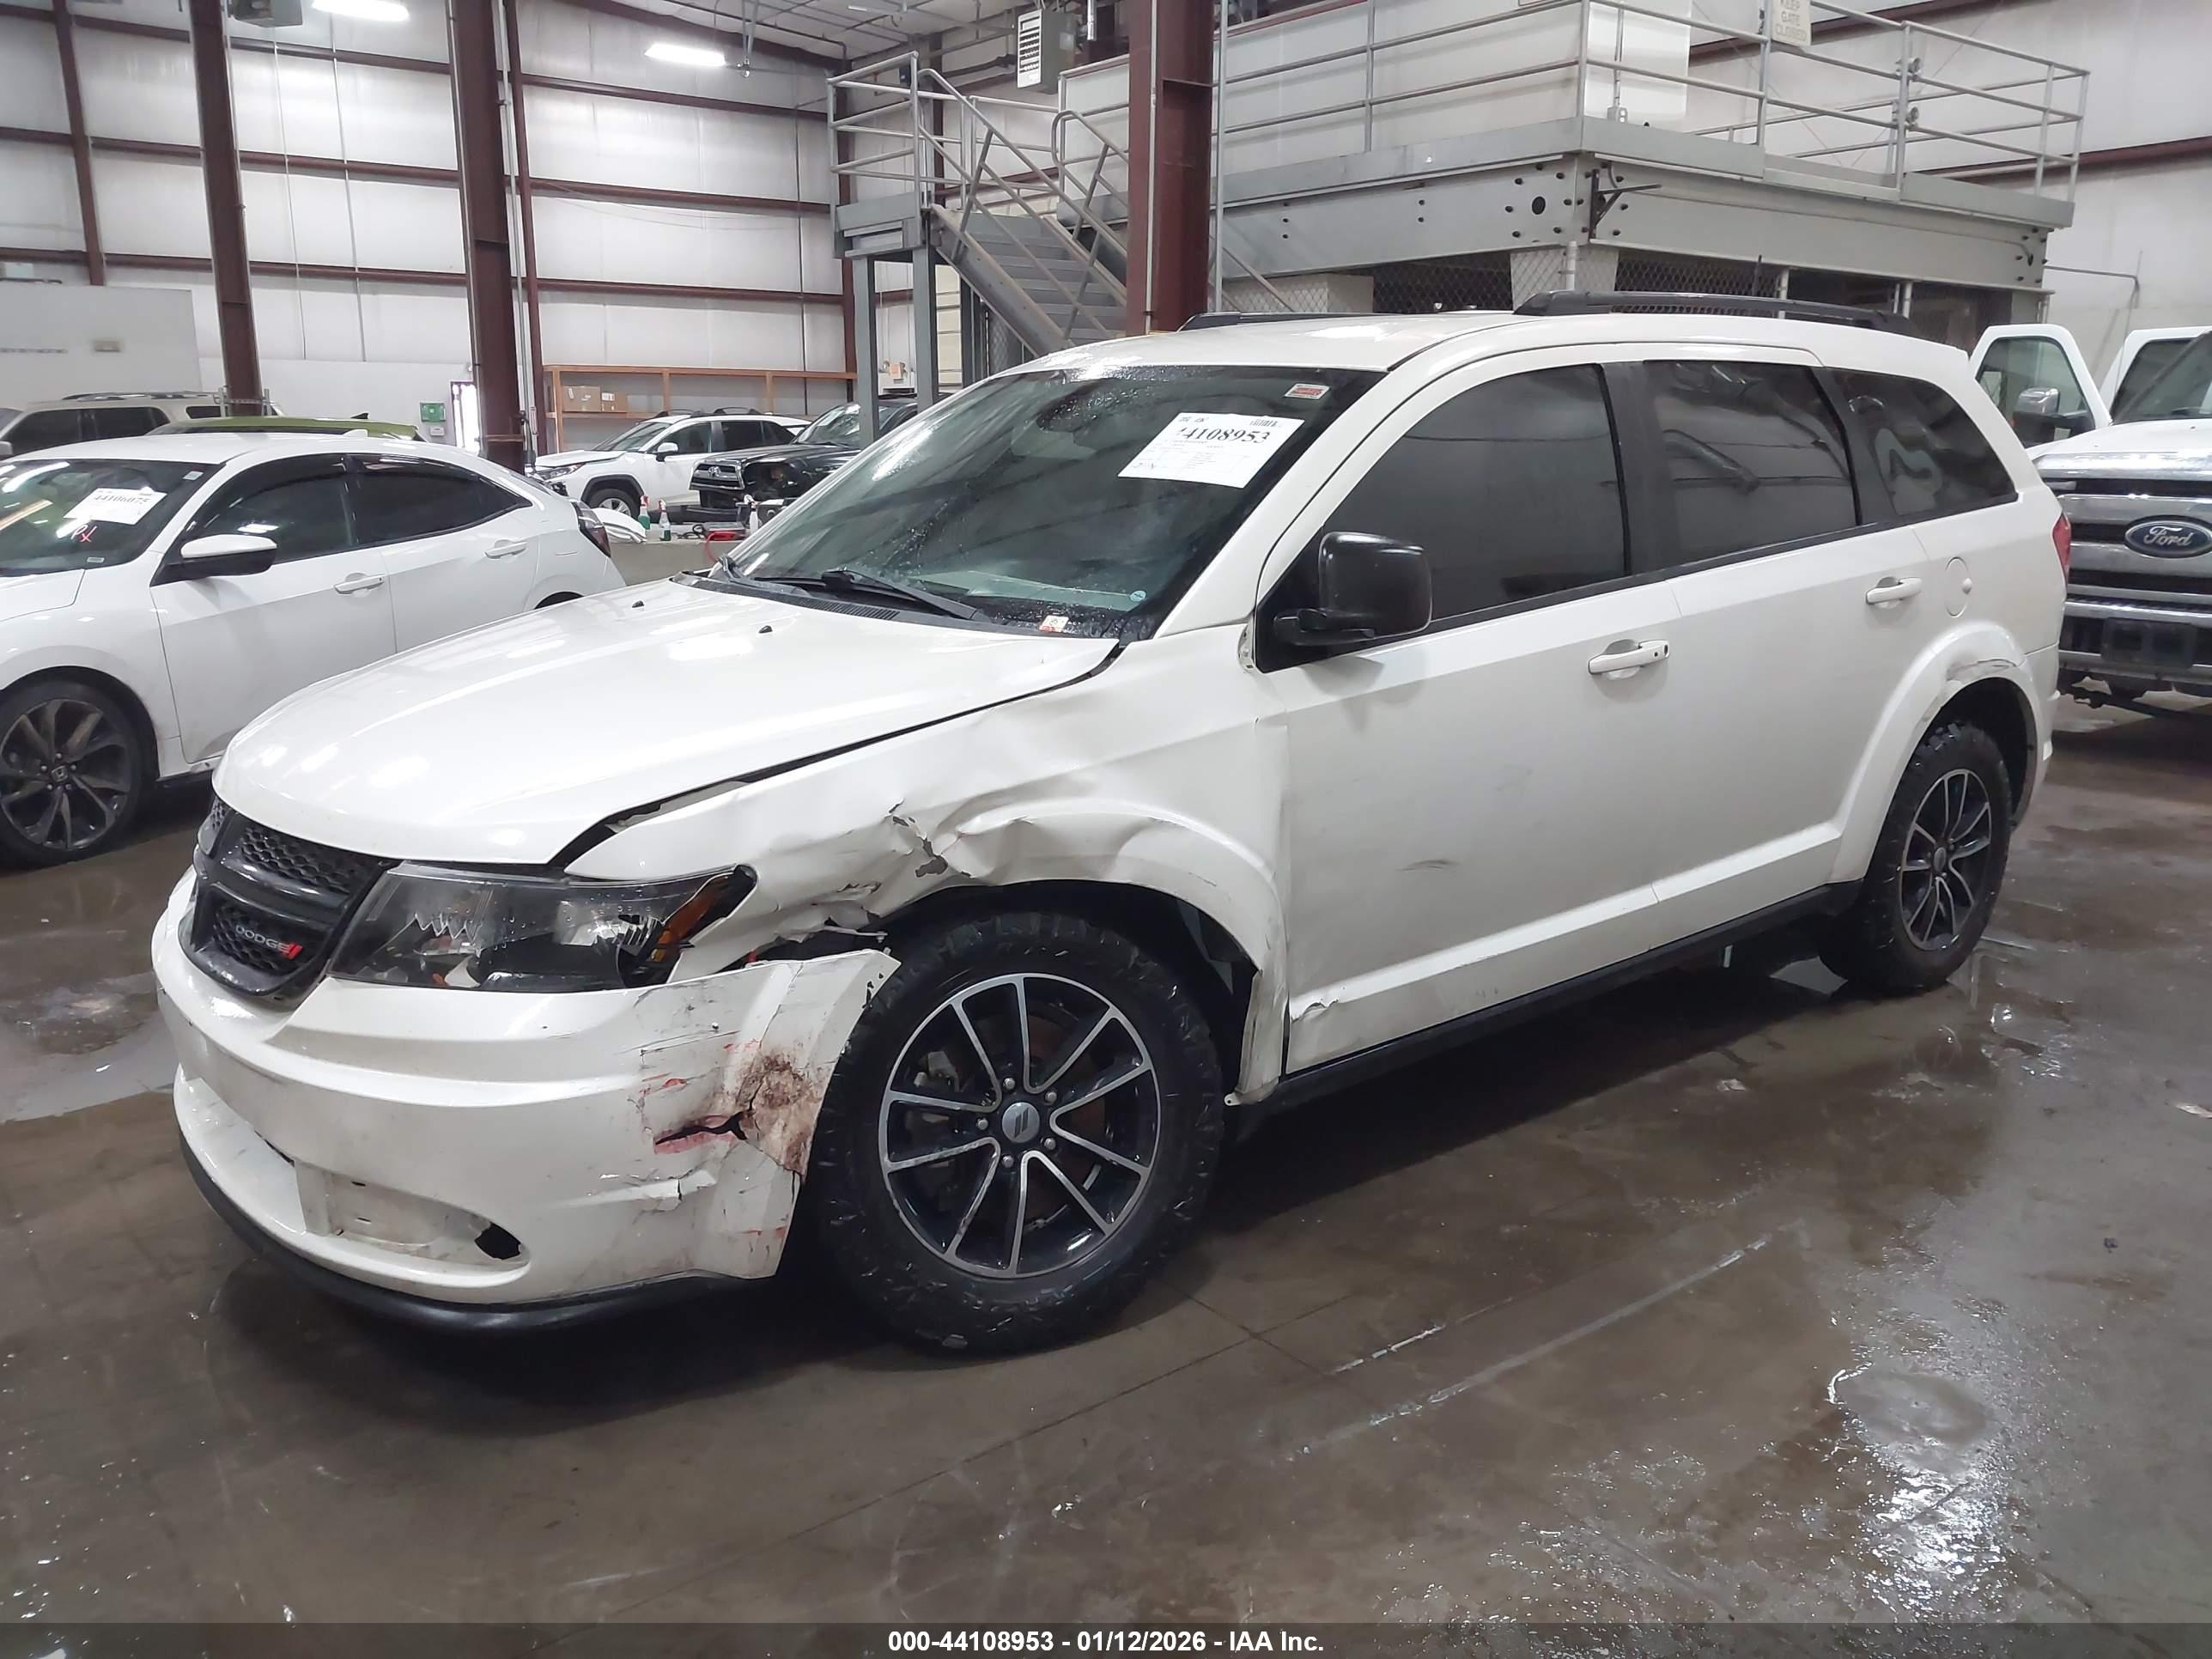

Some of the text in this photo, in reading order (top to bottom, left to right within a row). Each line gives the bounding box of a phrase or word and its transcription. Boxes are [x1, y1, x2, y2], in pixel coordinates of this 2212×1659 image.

[1781, 10, 1801, 27] GATE
[1775, 23, 1808, 42] CLOSED
[2143, 526, 2194, 546] Ford
[235, 925, 290, 954] DODGE
